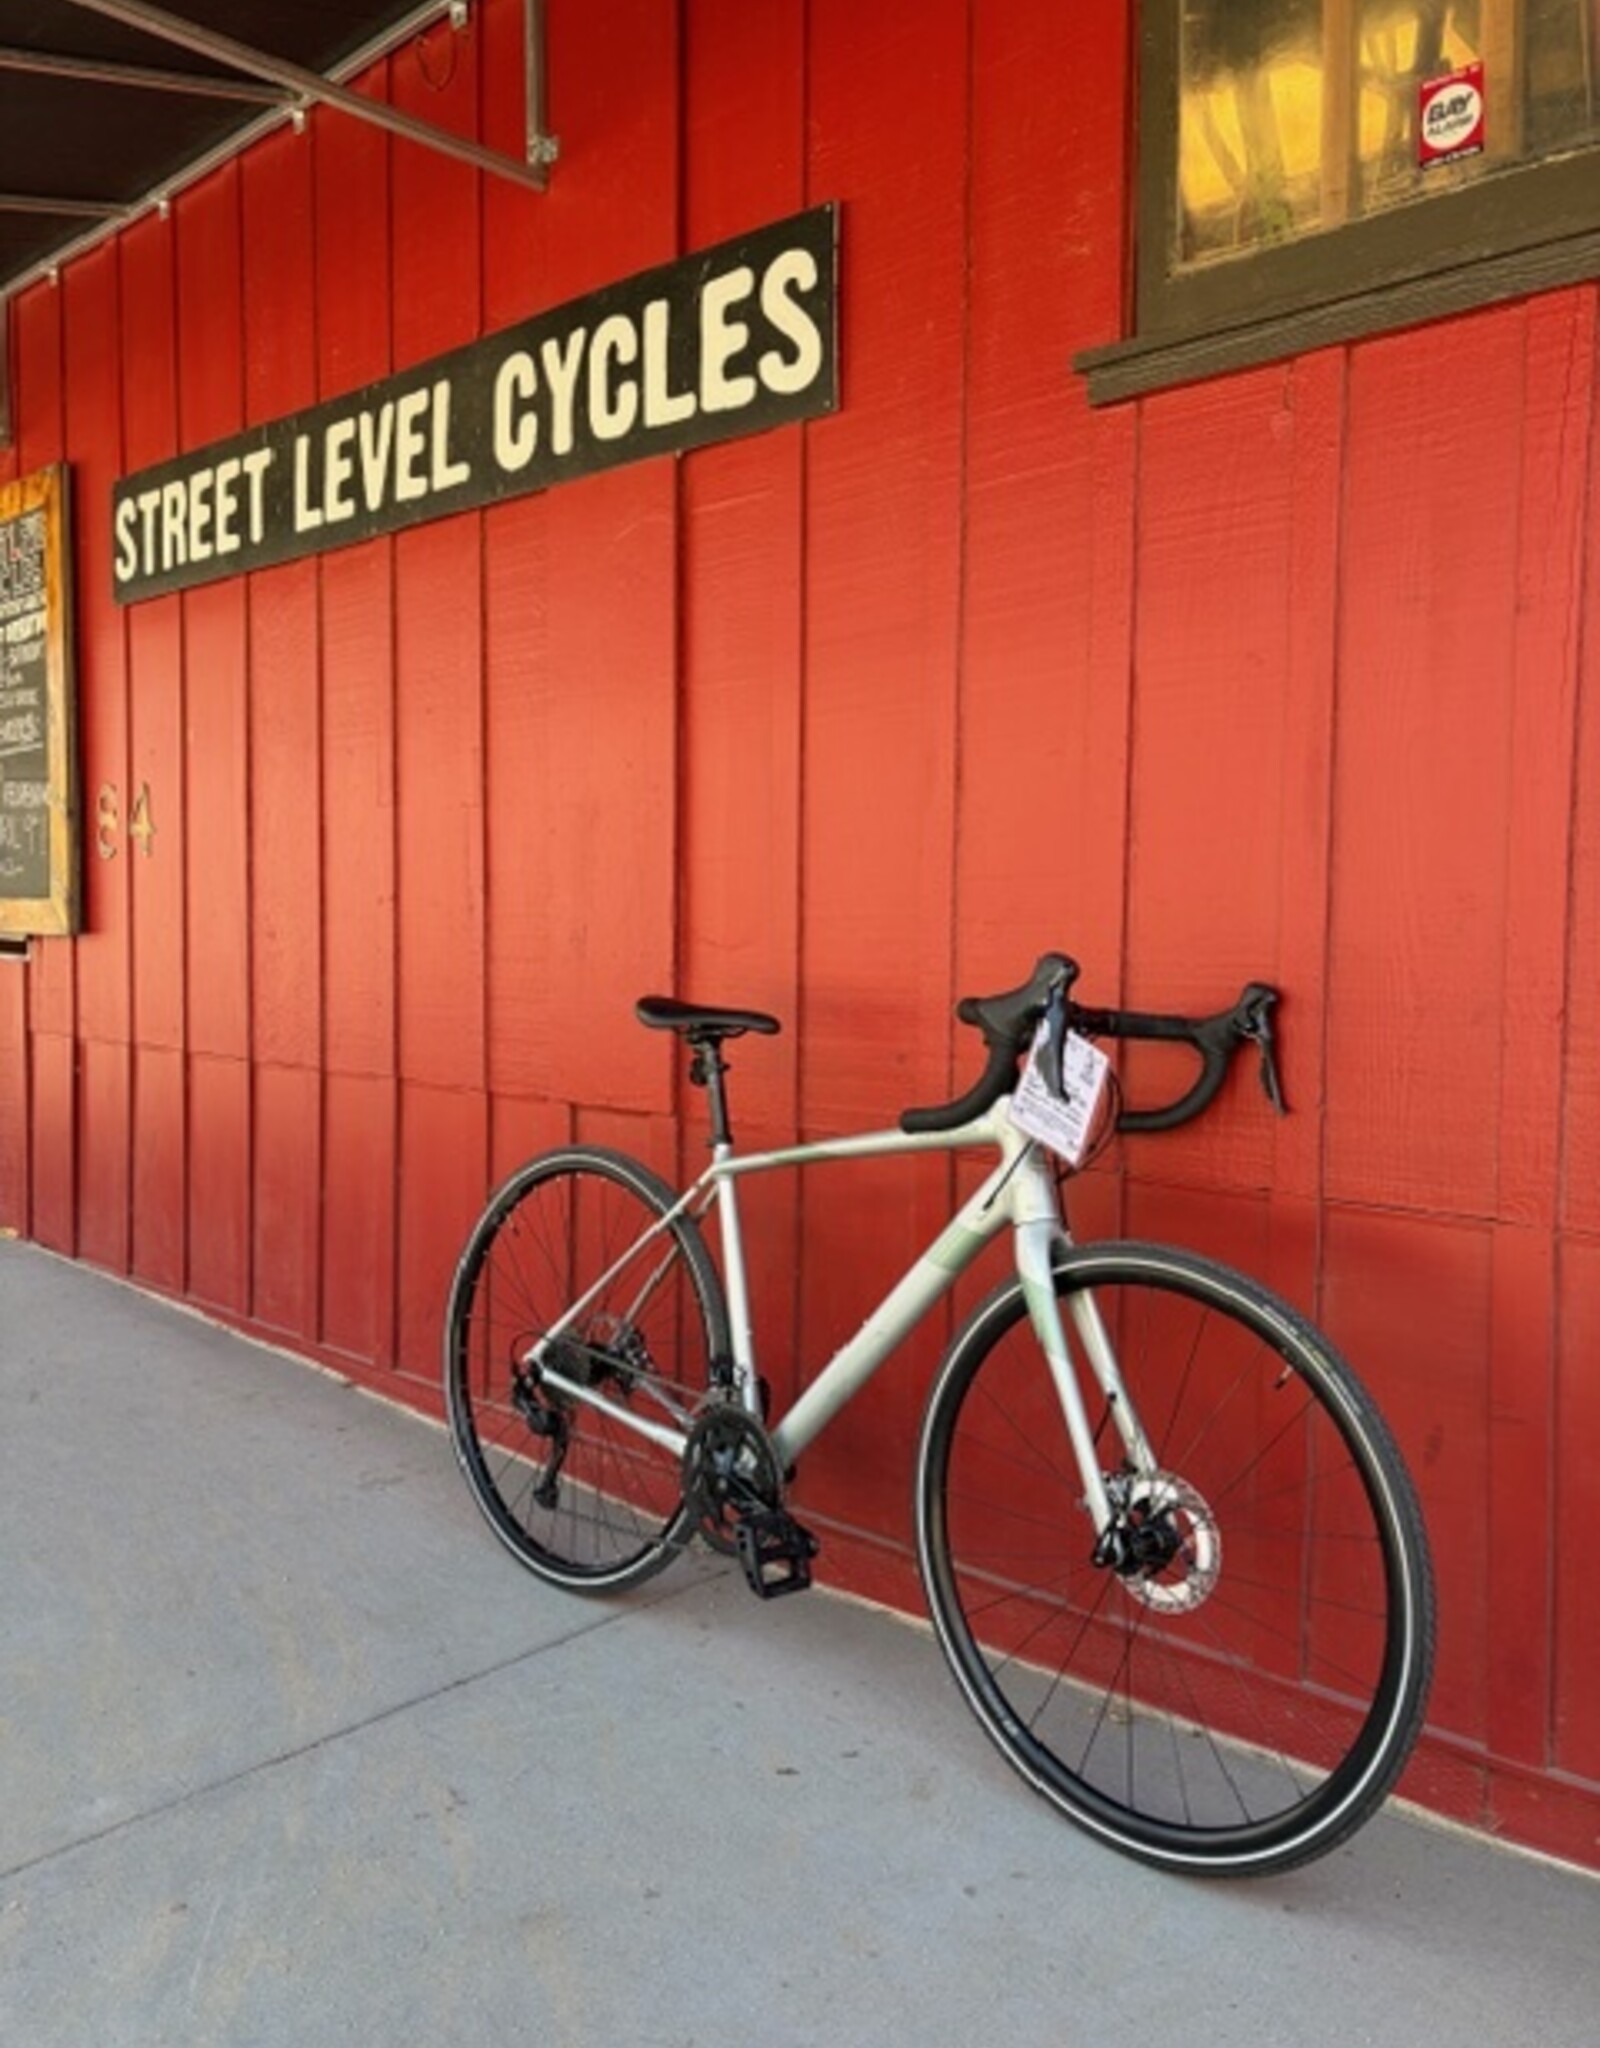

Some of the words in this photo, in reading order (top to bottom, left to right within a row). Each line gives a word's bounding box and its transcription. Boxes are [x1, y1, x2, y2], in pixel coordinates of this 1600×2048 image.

[1428, 91, 1475, 124] BAY
[115, 448, 275, 582] STREET
[294, 380, 472, 533] LEVEL
[493, 248, 823, 473] CYCLES
